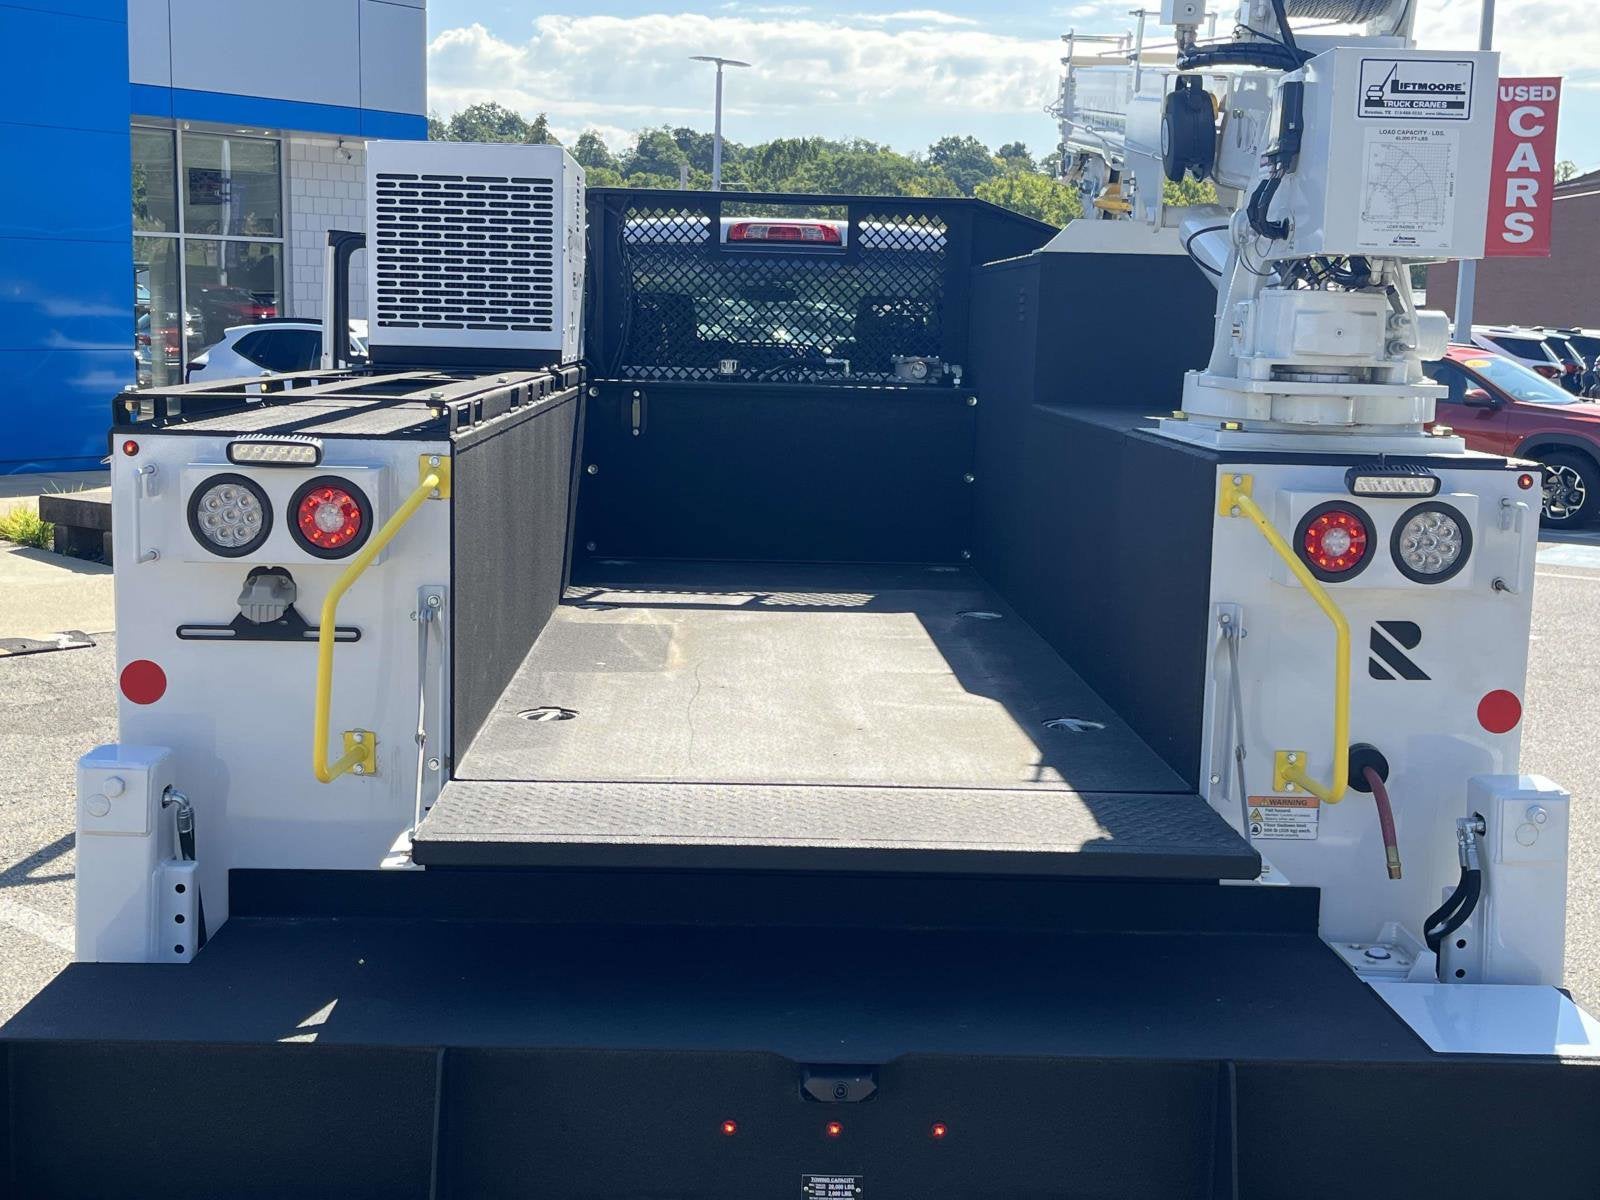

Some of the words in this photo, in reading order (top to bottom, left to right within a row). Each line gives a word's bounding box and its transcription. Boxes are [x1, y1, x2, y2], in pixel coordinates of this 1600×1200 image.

[1500, 86, 1556, 102] USED
[1383, 100, 1411, 108] TRUCK
[1413, 101, 1447, 109] CRANES
[1502, 106, 1544, 243] CARS
